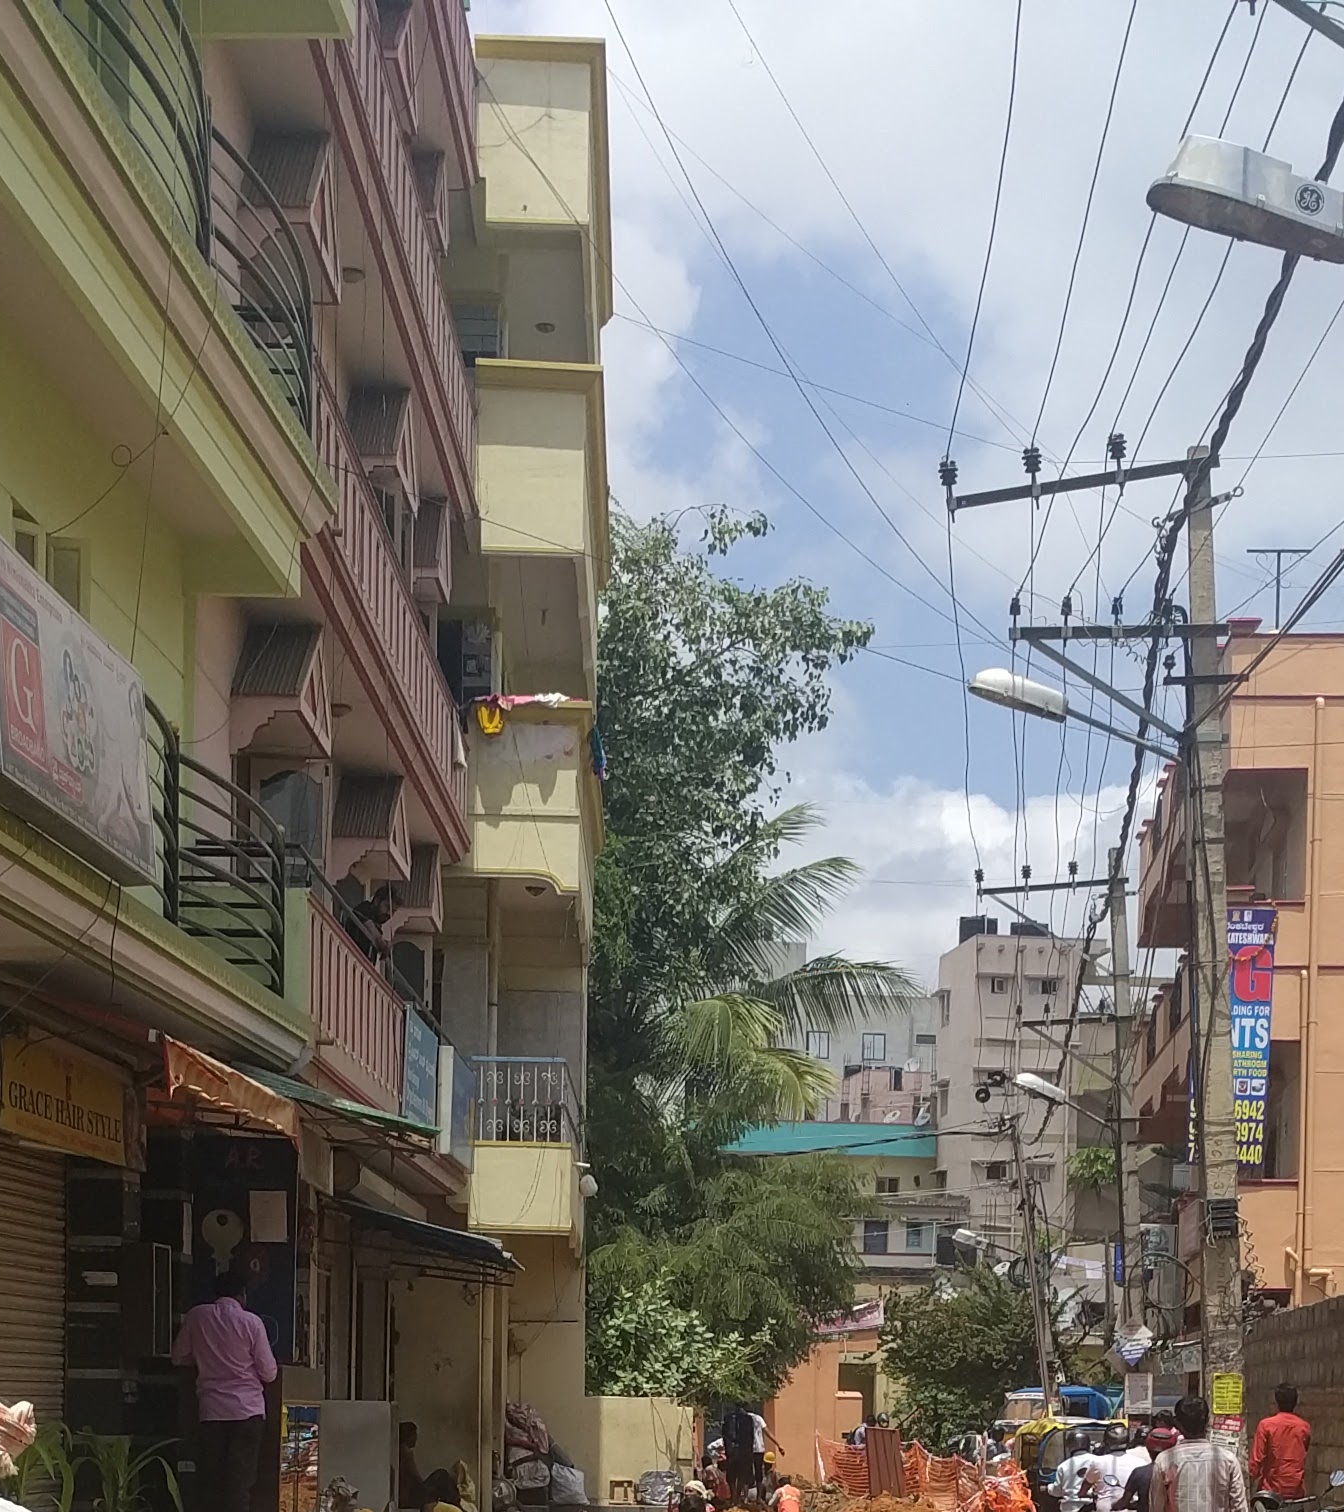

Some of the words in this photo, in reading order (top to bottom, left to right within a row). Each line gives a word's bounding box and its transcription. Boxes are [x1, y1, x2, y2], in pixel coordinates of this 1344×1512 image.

[10, 637, 39, 736] G
[1228, 945, 1272, 1002] G
[1231, 1005, 1253, 1016] DING
[1254, 1006, 1271, 1016] FOR
[8, 1081, 52, 1120] GRACE
[56, 1098, 85, 1133] HAIR
[87, 1110, 122, 1143] STYLE
[1236, 1144, 1263, 1165] 440
